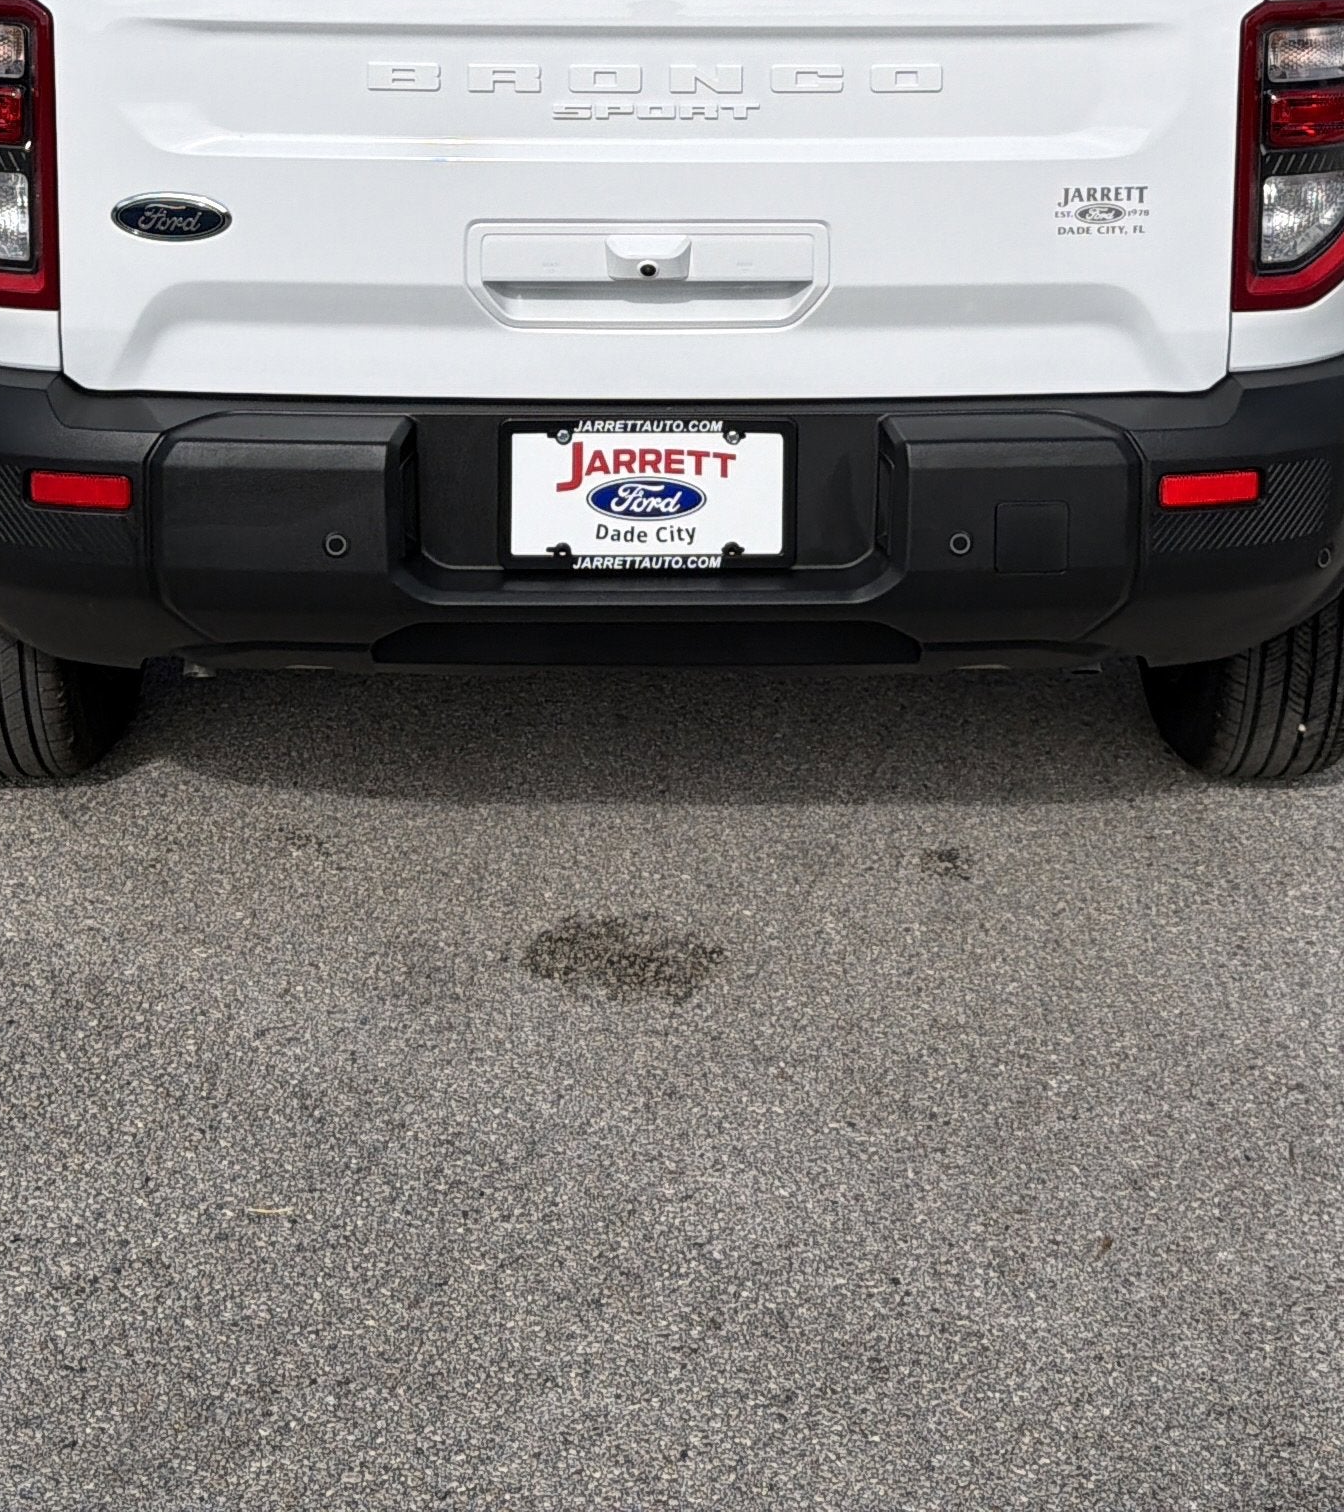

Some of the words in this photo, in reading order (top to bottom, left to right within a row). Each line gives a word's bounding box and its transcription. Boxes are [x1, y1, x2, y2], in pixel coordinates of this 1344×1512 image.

[366, 61, 944, 93] BRONCO
[552, 102, 760, 120] SPORT
[1057, 186, 1149, 207] JARRETT
[137, 203, 203, 231] Ford
[1085, 207, 1116, 221] Ford
[1057, 226, 1093, 235] DADE
[1096, 225, 1128, 235] CITY,
[1132, 224, 1145, 234] FL
[573, 419, 723, 433] JARRETTAUTO.COM
[555, 441, 737, 492] JARRETT
[609, 482, 681, 513] Ford
[595, 523, 648, 543] Dade
[655, 524, 697, 545] City
[572, 555, 722, 570] JARRETTAUTO.COM
